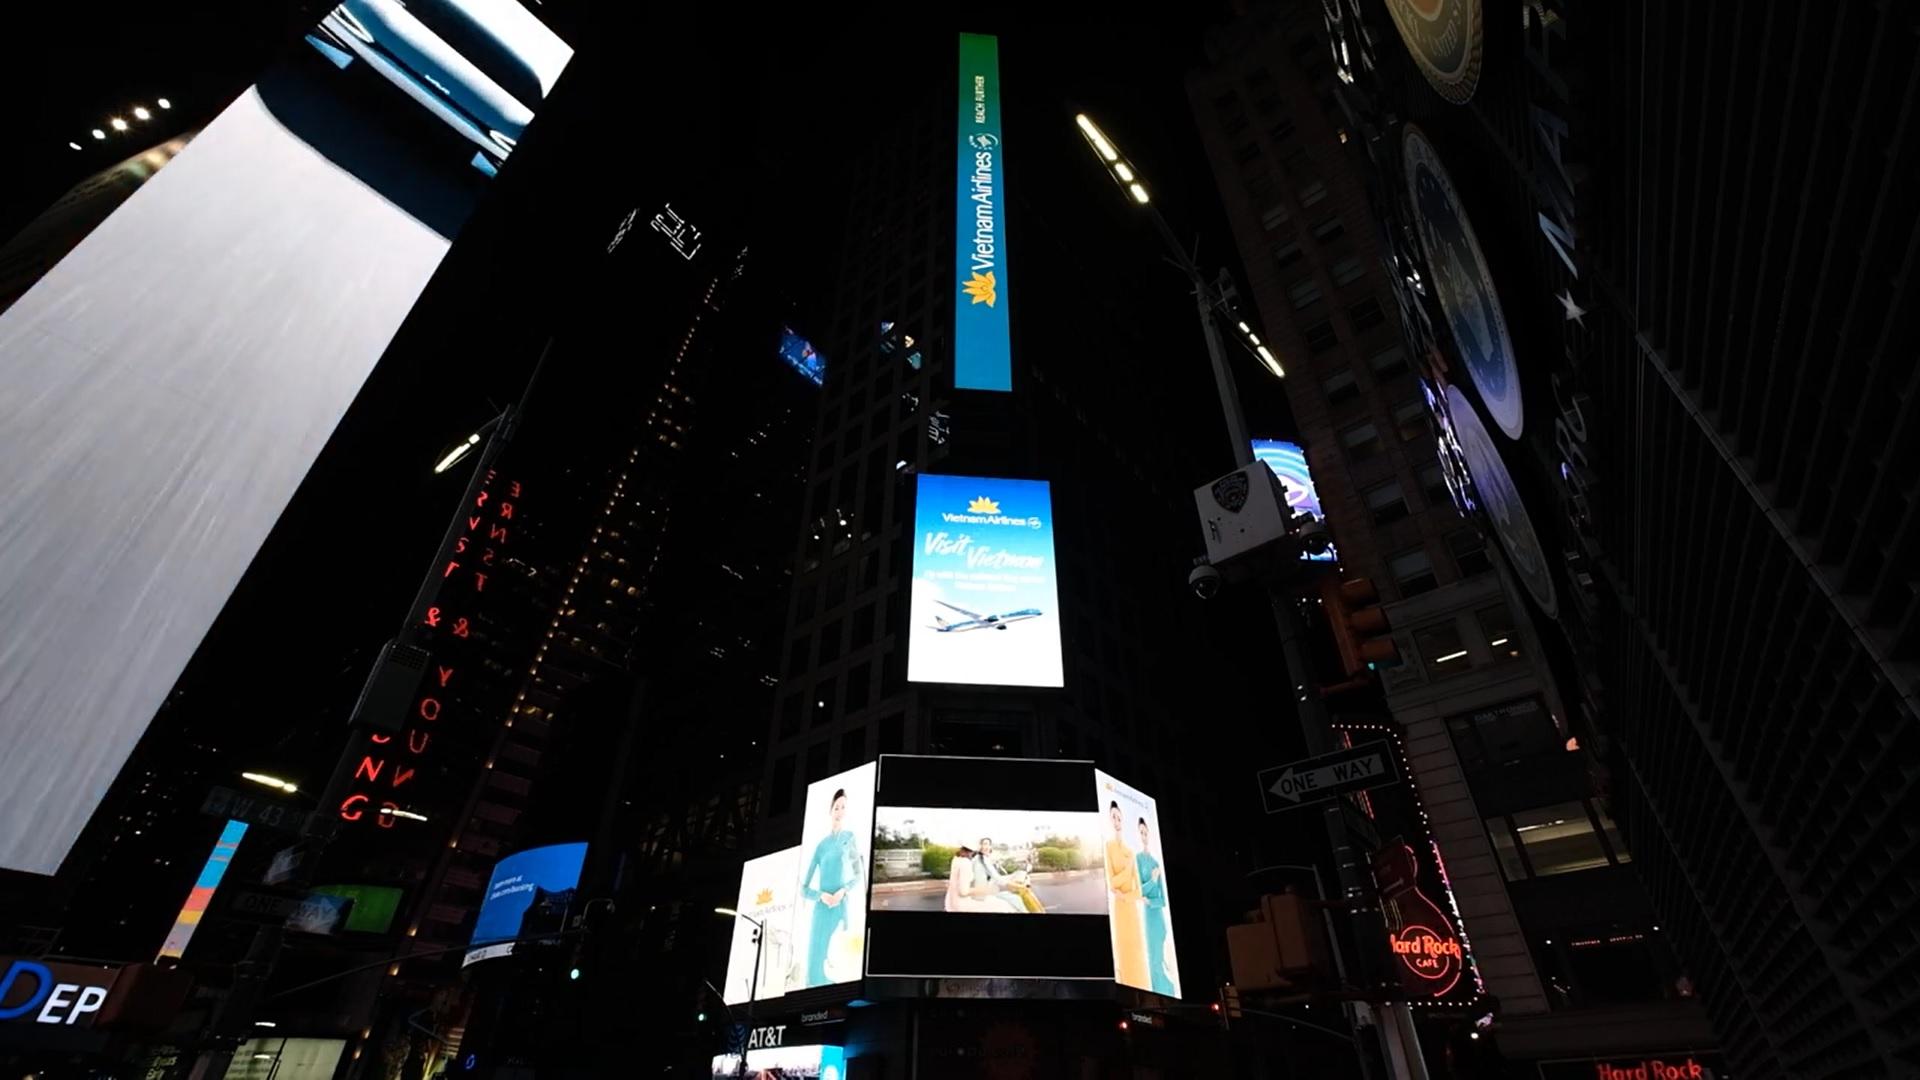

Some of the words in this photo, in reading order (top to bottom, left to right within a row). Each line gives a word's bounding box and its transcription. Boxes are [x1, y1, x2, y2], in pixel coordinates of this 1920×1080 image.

[924, 531, 974, 556] Visit
[966, 546, 1044, 570] Vietnam
[1281, 772, 1318, 795] ONE
[1333, 758, 1371, 781] WAY
[259, 804, 286, 827] 43
[1422, 935, 1461, 961] Rock
[748, 1025, 787, 1048] AT&T
[1594, 1061, 1648, 1080] Hard
[1650, 1058, 1704, 1080] Rock
